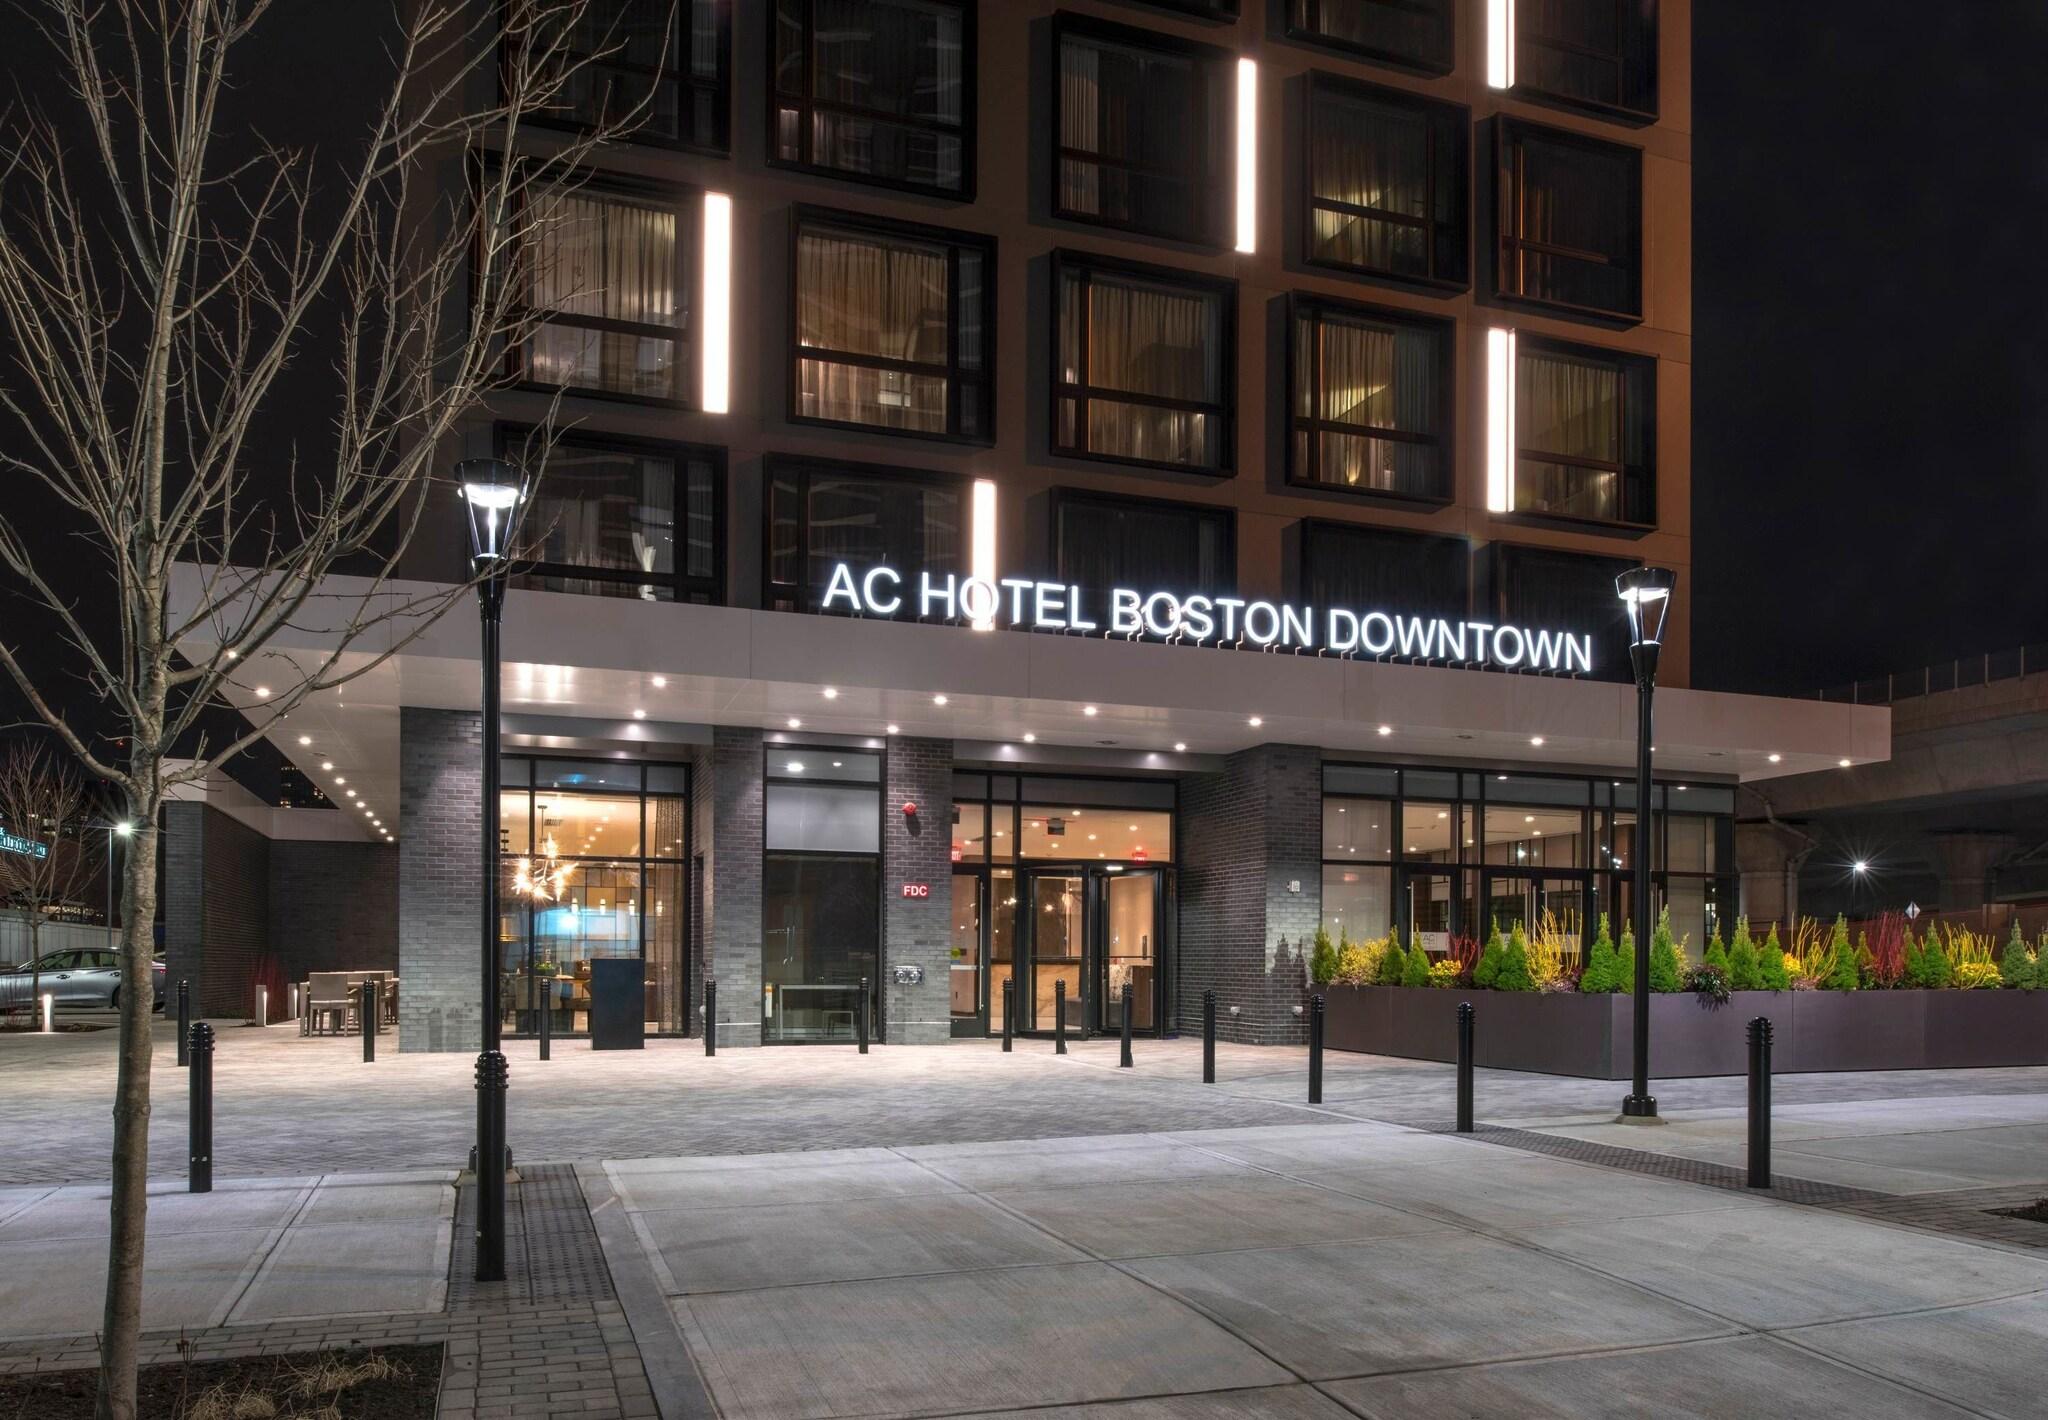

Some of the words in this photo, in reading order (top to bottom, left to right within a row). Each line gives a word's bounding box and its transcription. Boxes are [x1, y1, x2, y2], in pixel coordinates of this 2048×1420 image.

[822, 563, 901, 613] AC
[921, 571, 1096, 629] HOTEL
[1112, 588, 1312, 646] BOSTON
[1329, 609, 1591, 671] DOWNTOWN
[903, 885, 928, 896] FDC
